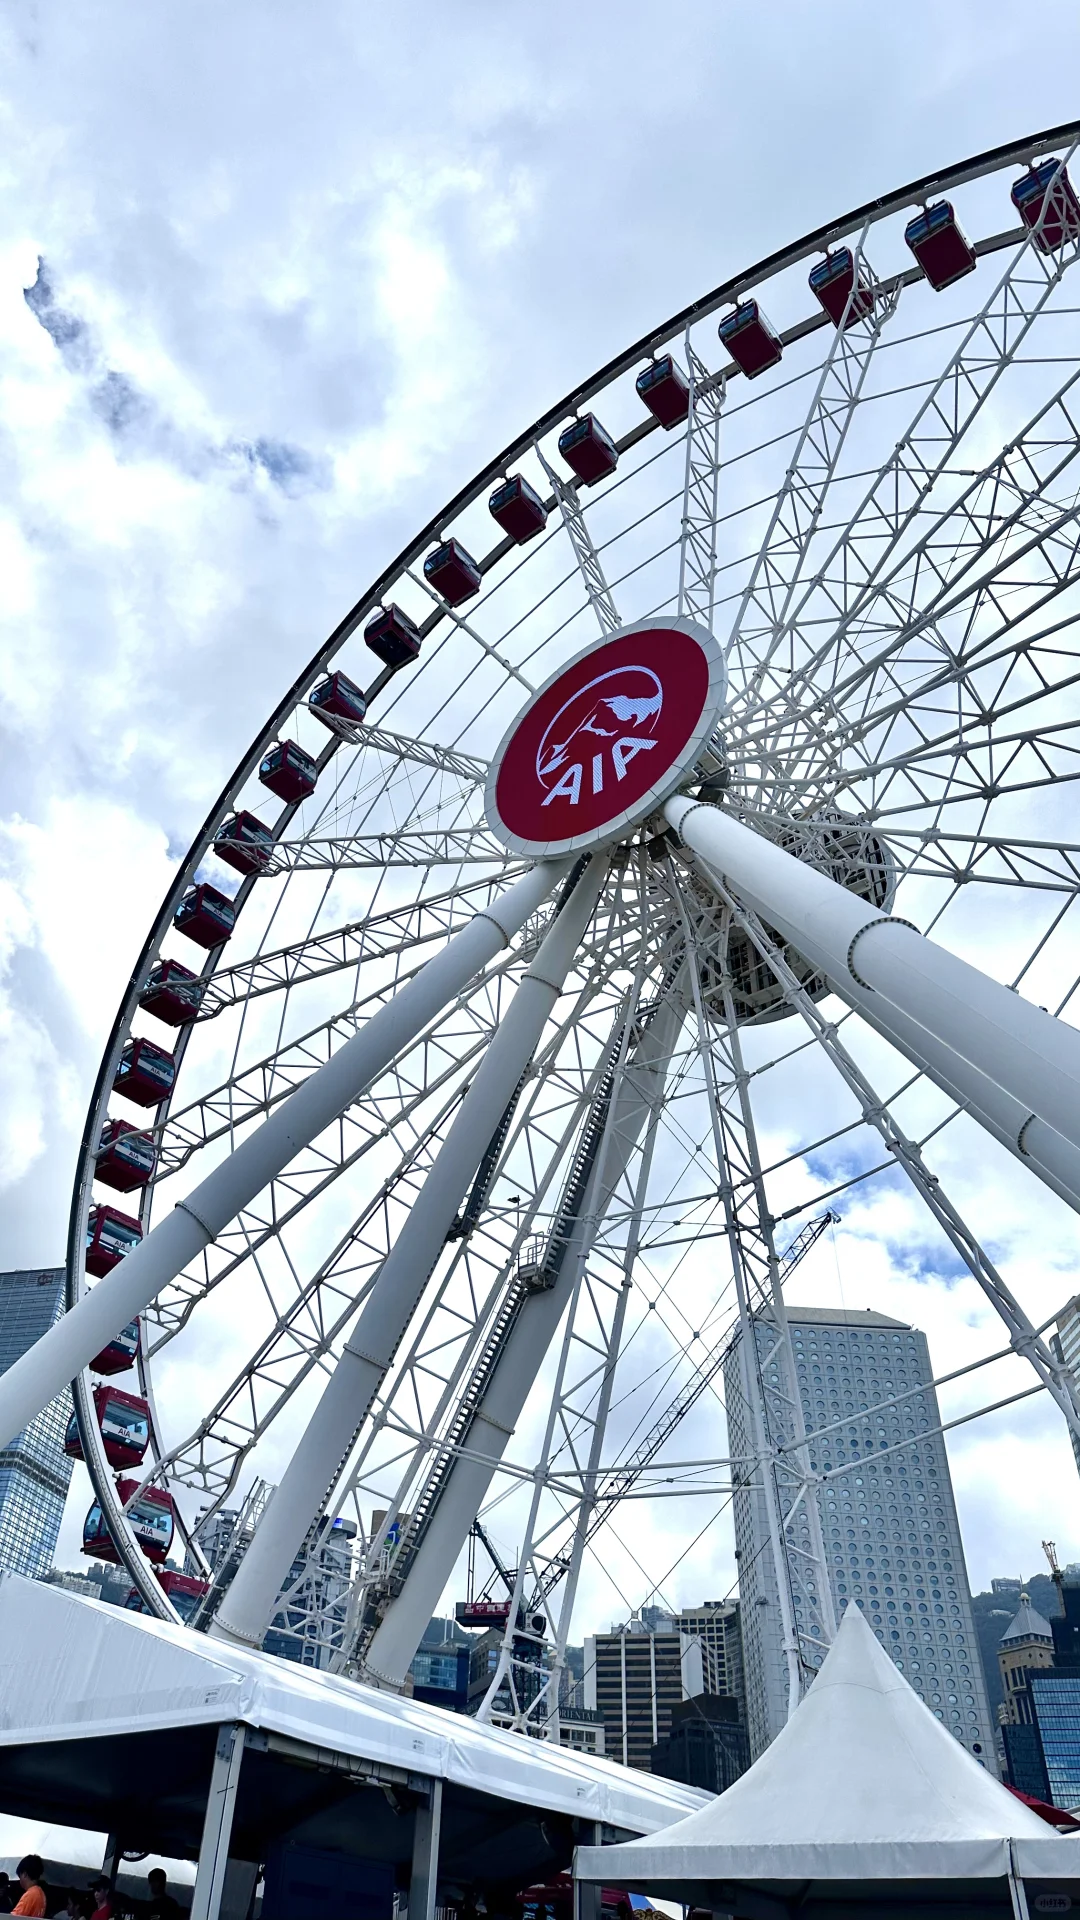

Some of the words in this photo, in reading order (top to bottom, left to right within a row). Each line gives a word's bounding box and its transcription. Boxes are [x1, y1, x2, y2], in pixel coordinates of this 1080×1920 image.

[541, 736, 659, 806] AIA
[129, 1151, 139, 1160] AIA
[114, 1240, 126, 1250] AIA
[118, 1427, 131, 1438] AIA
[140, 1525, 154, 1536] AIA
